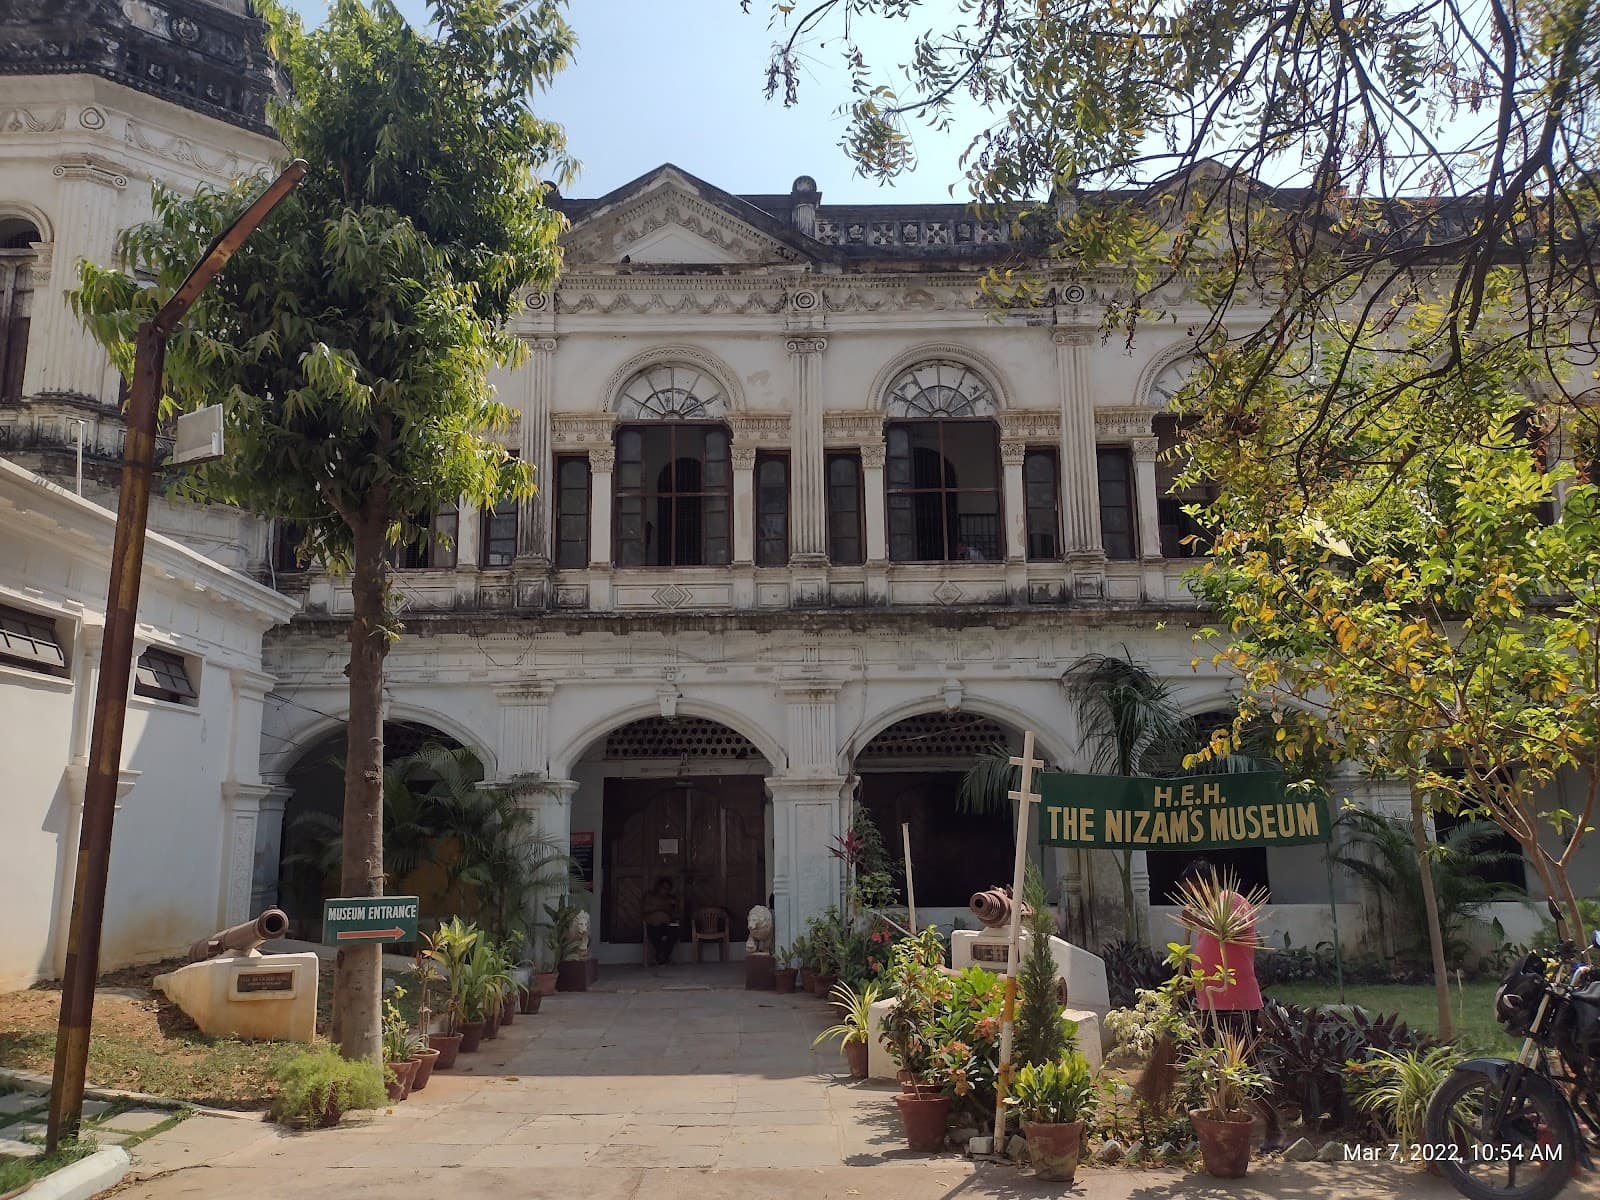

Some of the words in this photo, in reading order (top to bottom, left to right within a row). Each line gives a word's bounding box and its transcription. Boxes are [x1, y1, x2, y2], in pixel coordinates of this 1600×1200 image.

[1154, 783, 1226, 807] H.E.H.
[1047, 806, 1095, 842] THE
[1105, 807, 1204, 843] NIZAM'S
[1210, 802, 1319, 842] MUSEUM
[328, 907, 365, 920] MUSEUM
[368, 905, 416, 919] ENTRANCE
